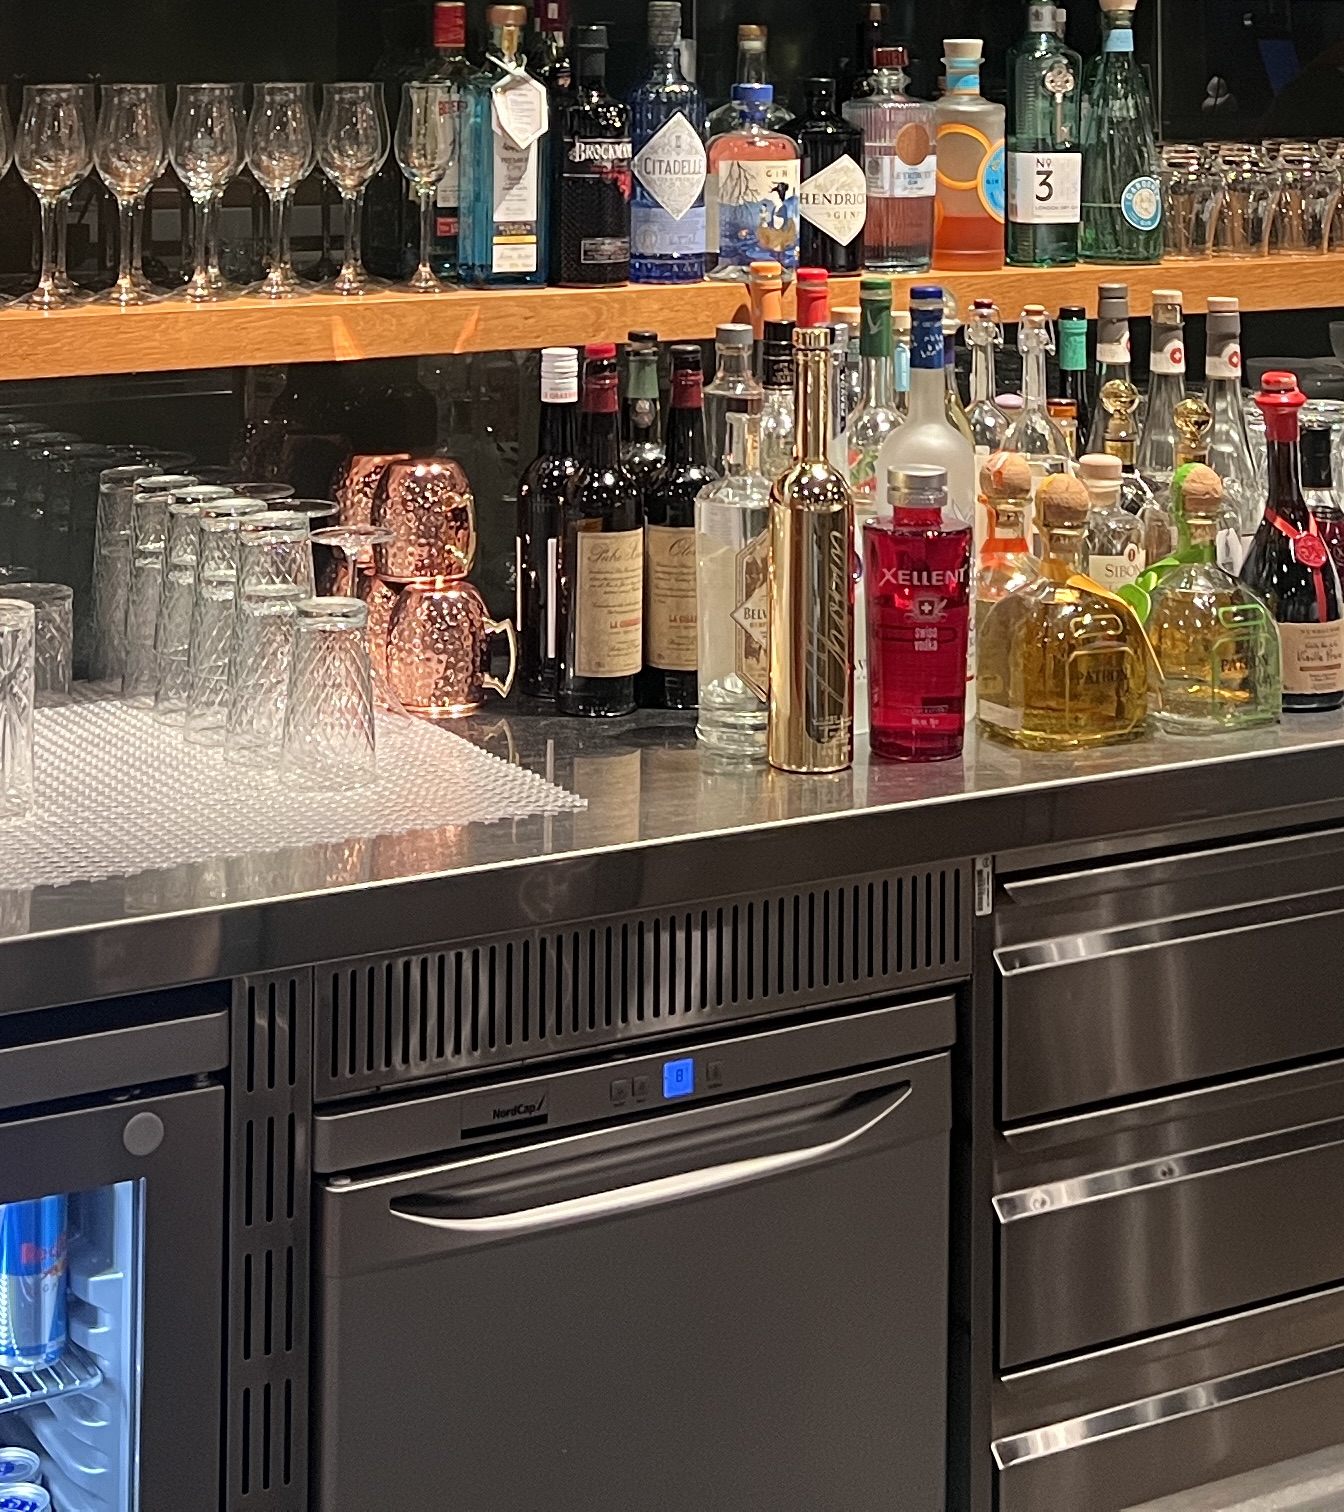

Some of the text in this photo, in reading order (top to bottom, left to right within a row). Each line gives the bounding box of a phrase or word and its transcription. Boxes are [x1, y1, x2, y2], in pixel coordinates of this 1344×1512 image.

[643, 156, 704, 176] CITADELLE
[765, 169, 788, 178] GIN
[1035, 169, 1055, 202] 3
[833, 211, 856, 221] GIN
[879, 567, 968, 587] XELLENT
[492, 1101, 537, 1120] NordCap
